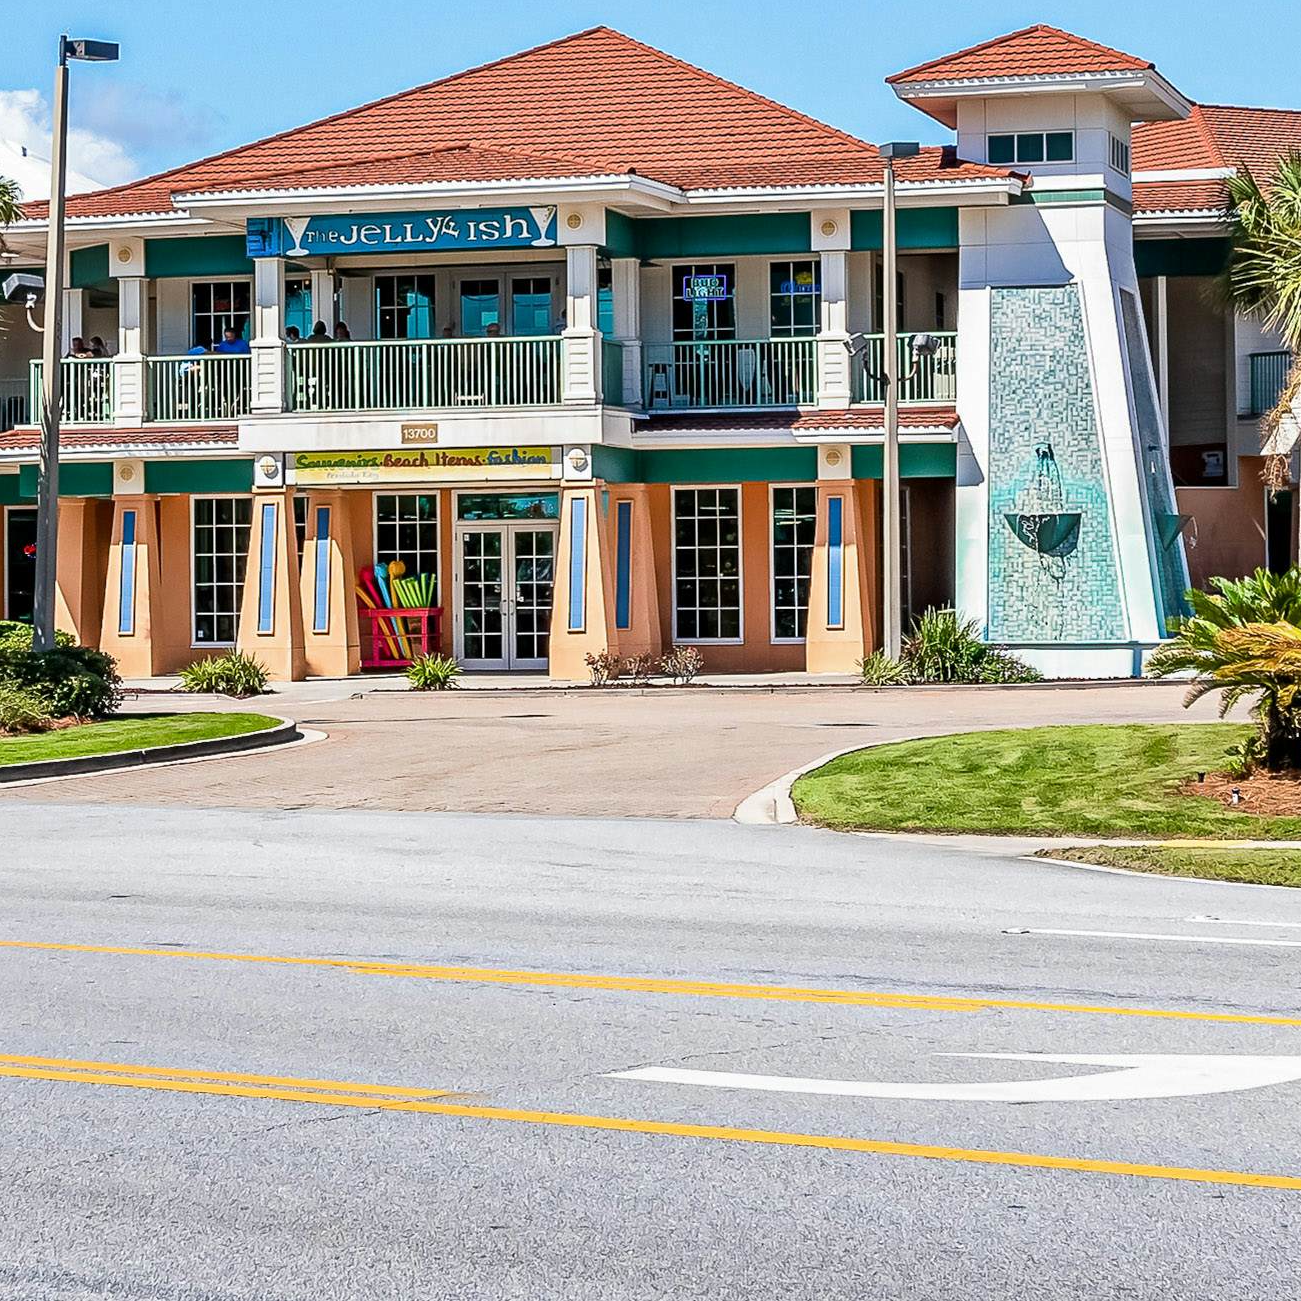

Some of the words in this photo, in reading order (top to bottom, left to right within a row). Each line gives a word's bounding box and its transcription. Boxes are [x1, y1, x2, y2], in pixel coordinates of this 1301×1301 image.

[691, 277, 719, 287] BUD
[685, 287, 724, 298] LIGHT
[402, 427, 436, 440] 13700
[383, 451, 429, 467] Beach
[435, 452, 483, 467] Items
